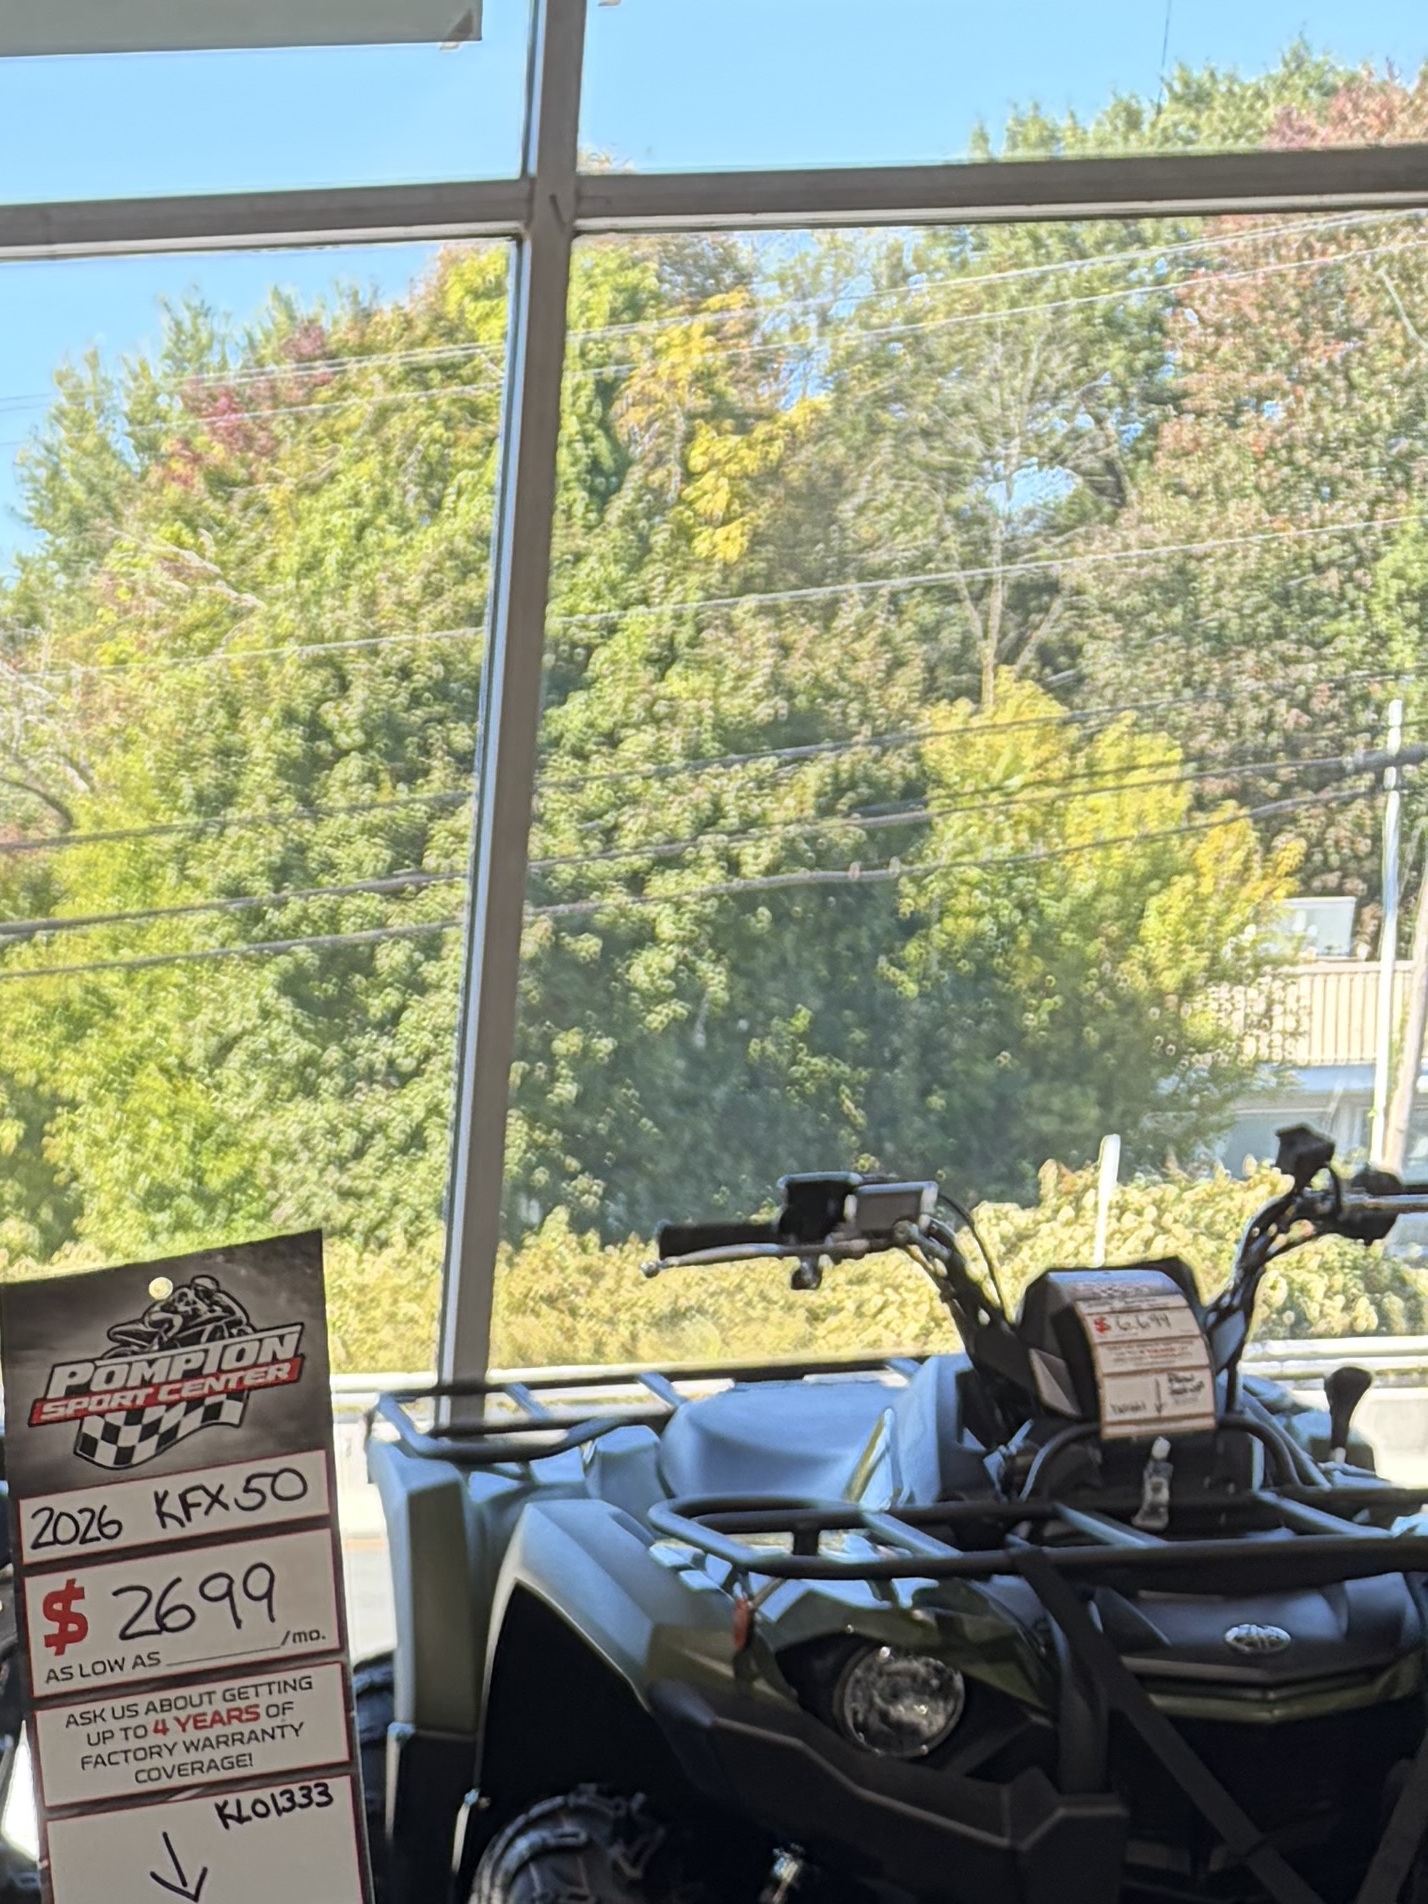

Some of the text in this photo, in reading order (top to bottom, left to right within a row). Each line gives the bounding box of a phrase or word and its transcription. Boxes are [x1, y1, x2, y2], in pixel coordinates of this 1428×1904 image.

[46, 1326, 301, 1400] POMPTON
[41, 1362, 293, 1420] SPORT CENTER
[30, 1504, 123, 1550] 2026
[42, 1561, 277, 1656] $ 2699
[45, 1665, 74, 1684] AS
[79, 1656, 126, 1678] LOW
[132, 1651, 162, 1669] AS
[65, 1675, 314, 1729] ASK US ABOUT GETTING
[87, 1701, 295, 1748] UP TO 4 YEARS OF
[80, 1721, 305, 1771] FACTORY WARRANTY
[134, 1752, 254, 1784] COVERAGE!
